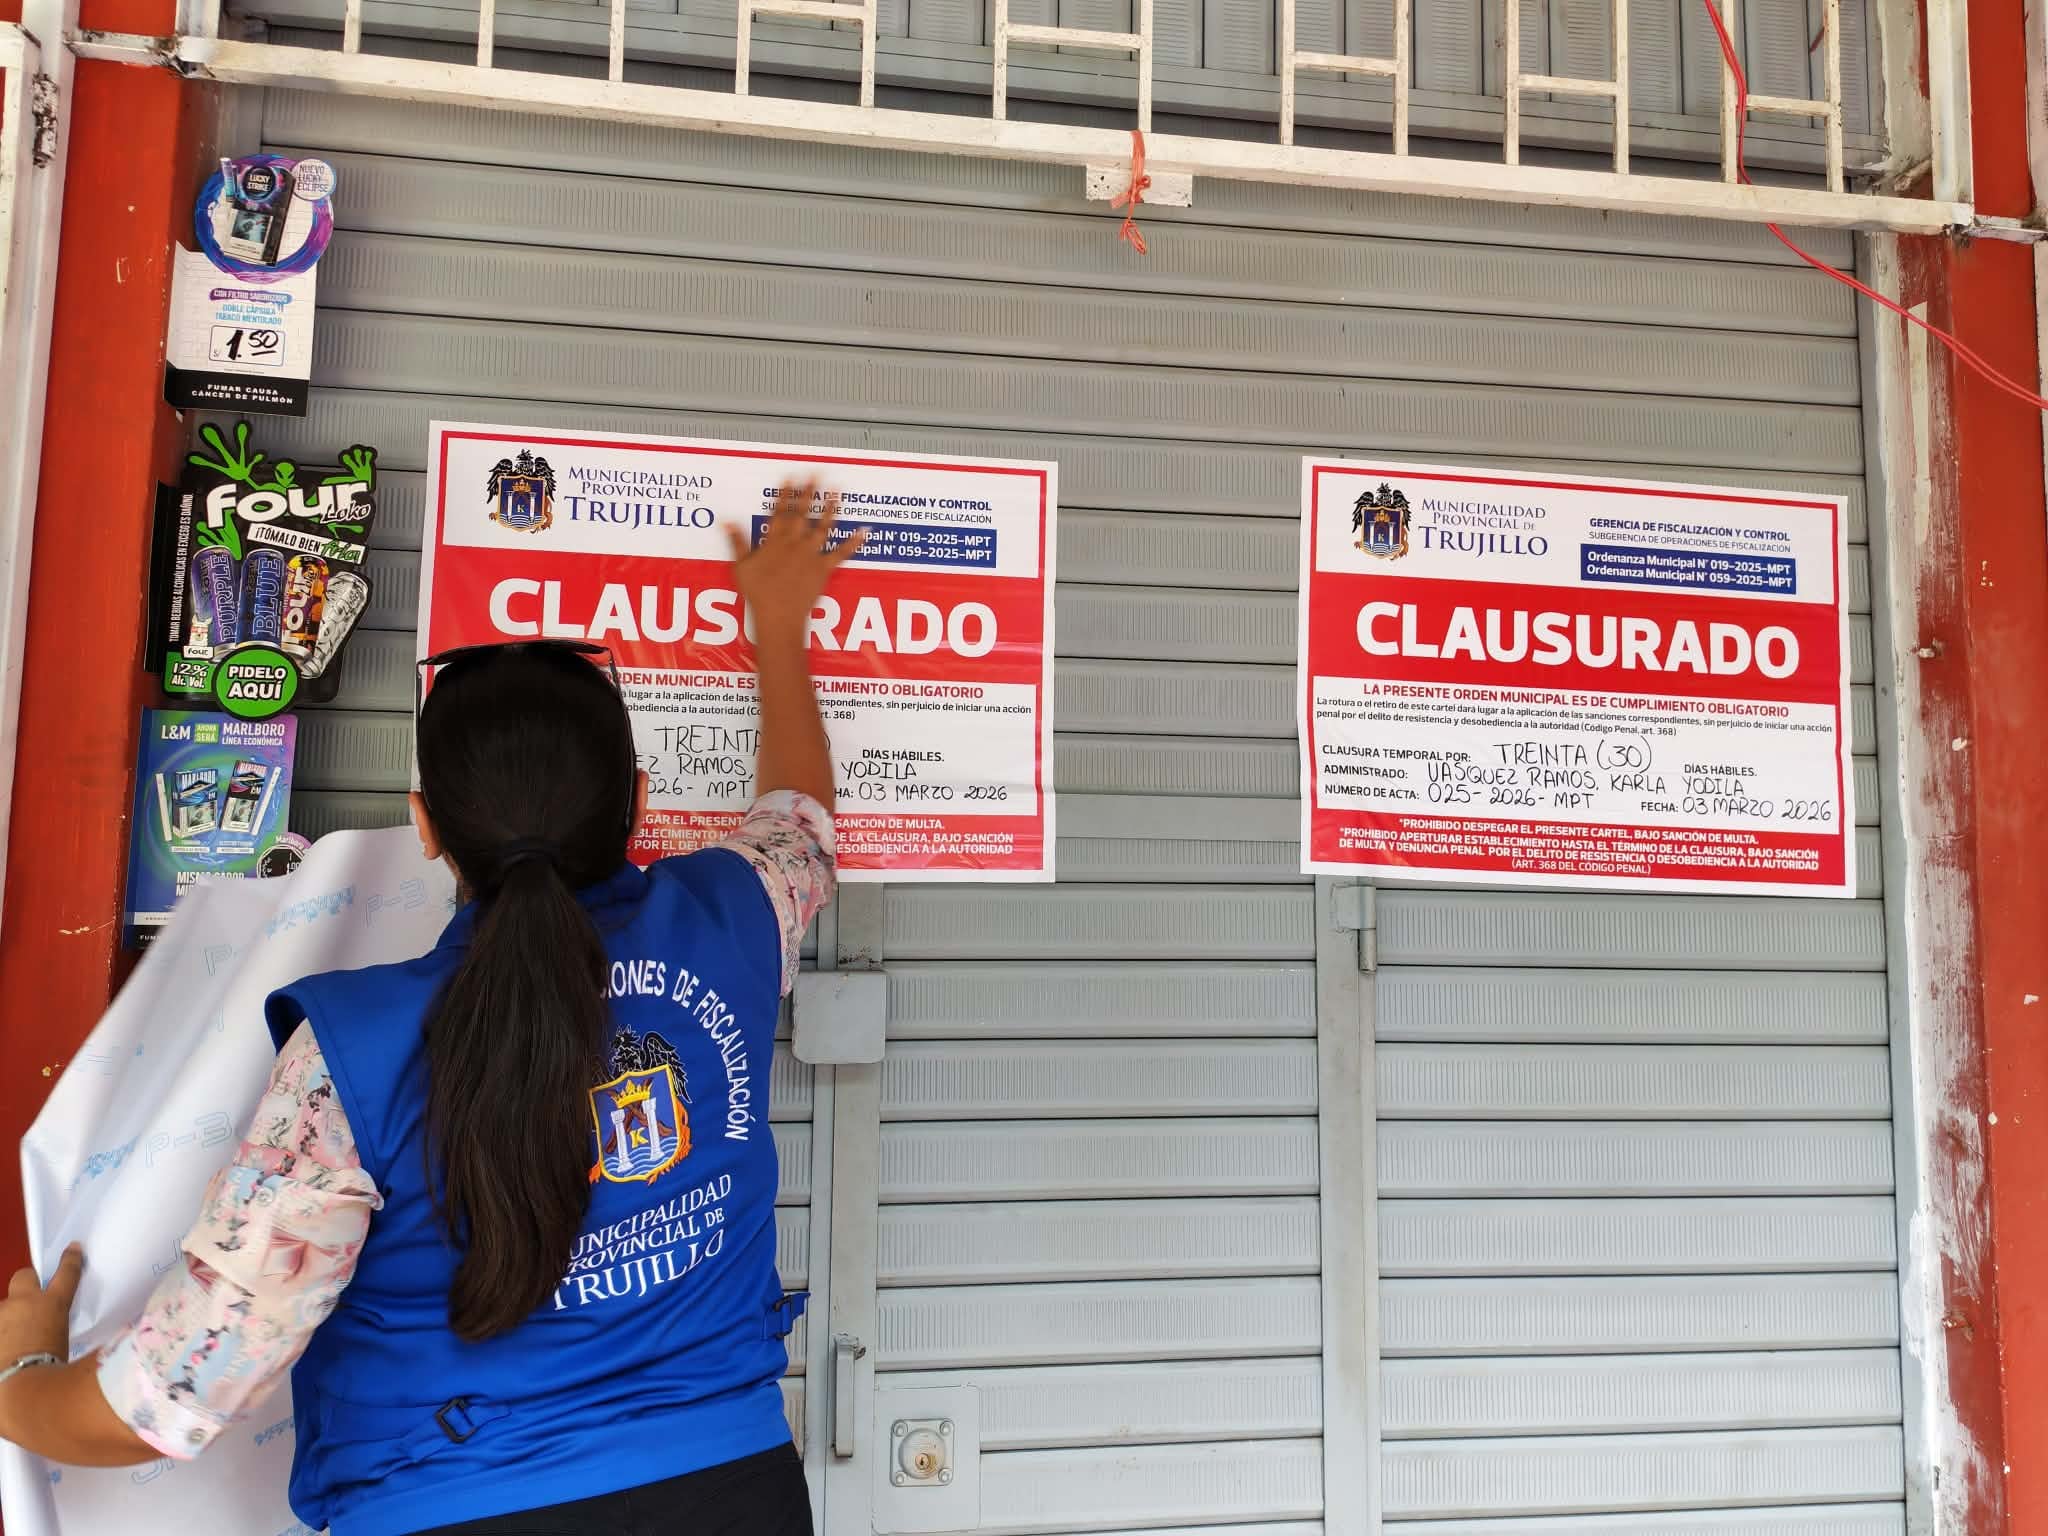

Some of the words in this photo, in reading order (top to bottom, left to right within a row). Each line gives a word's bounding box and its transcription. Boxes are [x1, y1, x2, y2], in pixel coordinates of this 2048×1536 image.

[247, 182, 270, 192] STRIKE
[249, 174, 270, 183] LUCKY
[207, 384, 241, 393] FUMAR
[245, 387, 279, 396] CAUSA
[235, 392, 249, 400] DE
[568, 466, 713, 489] MUNICIPALIDAD
[581, 481, 682, 501] PROVINCIAL
[686, 492, 701, 502] DE
[841, 492, 926, 506] FISCALIZACIÓN
[929, 498, 936, 507] Y
[938, 499, 992, 510] CONTROL
[1421, 498, 1546, 519] MUNICIPALIDAD
[564, 495, 715, 530] TRUJILLO
[843, 507, 908, 518] OPERACIONES
[910, 510, 922, 519] DE
[924, 511, 991, 523] FISCALIZACIÓN
[1433, 512, 1520, 530] PROVINCIAL
[1589, 518, 1640, 529] GERENCIA
[1642, 521, 1656, 531] DE
[1657, 522, 1732, 536] FISCALIZACIÓN
[1735, 528, 1741, 536] Y
[1743, 529, 1790, 541] CONTROL
[299, 537, 321, 553] BIEN
[1418, 525, 1548, 559] TRUJILLO
[1588, 531, 1646, 542] SUBGERENCIA
[1648, 535, 1658, 543] DE
[1660, 536, 1718, 547] OPERACIONES
[1719, 540, 1729, 548] DE
[1731, 541, 1790, 552] FISCALIZACIÓN
[1587, 551, 1645, 564] Ordenanza
[1646, 555, 1695, 568] Municipal
[1586, 564, 1644, 577] Ordenanza
[1645, 568, 1694, 582] Municipal
[209, 554, 237, 642] PURPLE
[252, 557, 281, 637] BLUE
[489, 577, 998, 658] CLAUSRADO
[1356, 601, 1800, 680] CLAUSURADO
[173, 662, 209, 677] 12%
[228, 666, 287, 680] PIDELO
[227, 681, 283, 700] AQUÍ
[655, 674, 734, 687] MUNICIPAL
[737, 677, 755, 689] ES
[892, 684, 983, 698] OBLIGATORIO
[1363, 683, 1380, 694] LA
[1383, 684, 1450, 698] PRESENTE
[1453, 688, 1497, 700] ORDEN
[1500, 691, 1568, 704] MUNICIPAL
[1572, 695, 1587, 706] ES
[1590, 696, 1606, 707] DE
[1609, 697, 1705, 712] CUMPLIMIENTO
[1707, 703, 1788, 716] OBLIGATORIO
[161, 724, 191, 740] L&M
[223, 722, 285, 737] MARLBORO
[862, 748, 889, 759] DÍAS
[892, 750, 944, 761] HÁBILES.
[1322, 744, 1380, 757] CLAUSURA
[1382, 748, 1443, 760] TEMPORAL
[1445, 751, 1470, 763] POR:
[1493, 741, 1587, 767] TREINTA
[1596, 735, 1652, 774] (30)
[840, 761, 917, 780] YODILA
[1324, 764, 1407, 778] ADMINISTRADO:
[1684, 763, 1708, 774] DÍAS
[1710, 765, 1756, 776] HÁBILES.
[706, 779, 751, 799] MPT
[858, 781, 887, 801] 03
[895, 784, 954, 802] MARZO
[964, 785, 1008, 801] 2026
[1324, 784, 1370, 796] NÚMERO
[1373, 787, 1386, 797] DE
[1388, 788, 1419, 799] ACTA:
[1610, 773, 1666, 794] KARLA
[1682, 775, 1745, 797] YODILA
[1554, 793, 1595, 809] MPT
[1641, 801, 1678, 812] FECHA:
[1682, 796, 1708, 815] 03
[1713, 797, 1774, 817] MARZO
[1781, 800, 1832, 821] 2026
[835, 818, 885, 828] SANCIÓN
[888, 817, 902, 828] DE
[905, 819, 944, 828] MULTA.
[933, 833, 961, 845] BAJO
[963, 832, 1013, 845] SANCIÓN
[1462, 821, 1518, 832] DESPEGAR
[1520, 824, 1533, 834] EL
[1534, 825, 1588, 836] PRESENTE
[1590, 827, 1632, 838] CARTEL,
[1634, 829, 1660, 839] BAJO
[1661, 831, 1706, 841] SANCIÓN
[1707, 832, 1721, 842] DE
[1723, 833, 1758, 844] MULTA.
[948, 843, 1013, 853] AUTORIDAD
[1511, 858, 1536, 868] (ART.
[1538, 860, 1556, 869] 368
[1558, 861, 1576, 870] DEL
[1578, 862, 1615, 872] CÓDIGO
[1616, 863, 1651, 874] PENAL)
[672, 968, 700, 1008] DE
[693, 989, 756, 1141] FISCALIZACIÓN
[629, 1128, 649, 1149] K
[569, 1174, 731, 1260] UNICIPALIDAD
[568, 1215, 701, 1274] ROVINCIAL
[704, 1208, 725, 1228] DE
